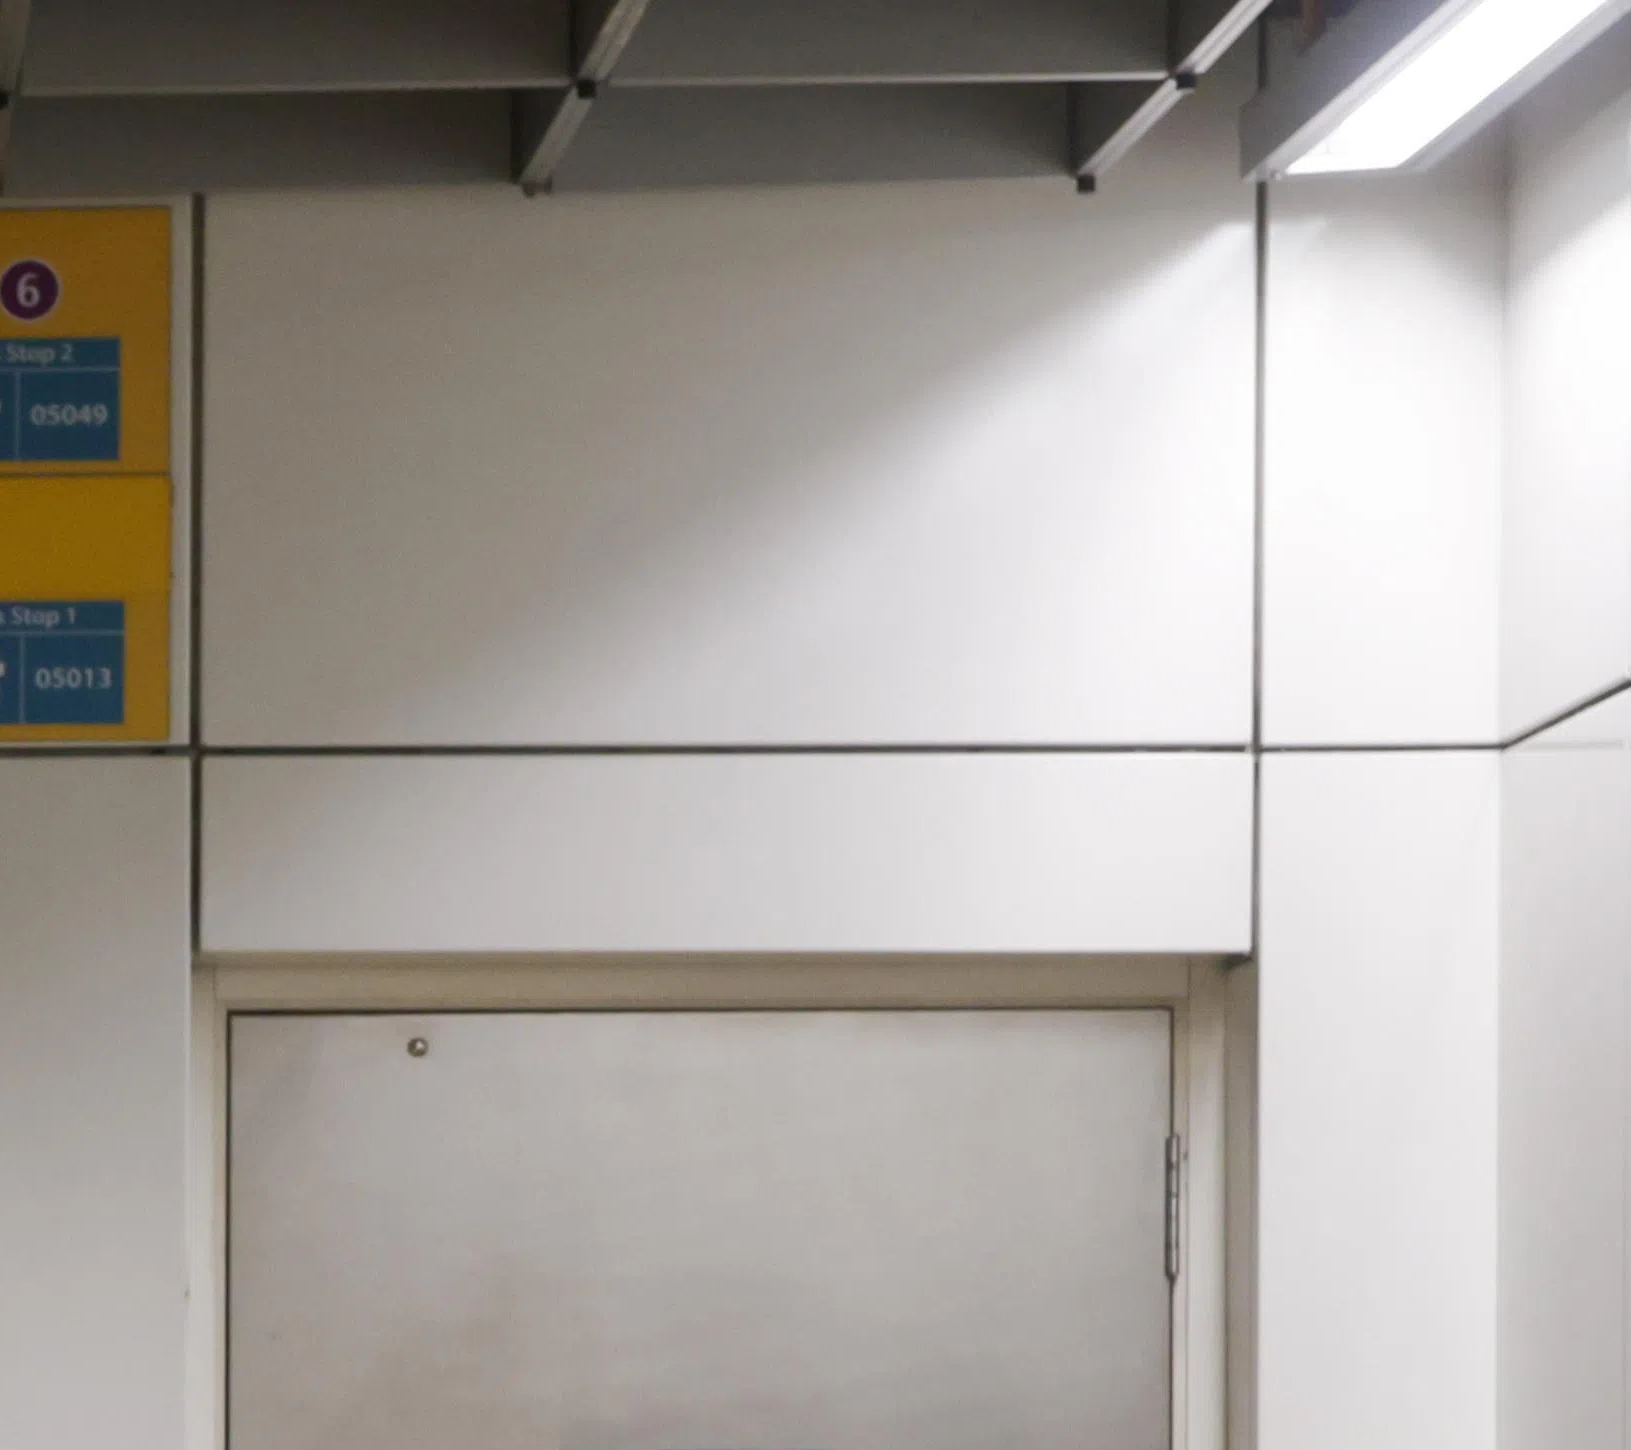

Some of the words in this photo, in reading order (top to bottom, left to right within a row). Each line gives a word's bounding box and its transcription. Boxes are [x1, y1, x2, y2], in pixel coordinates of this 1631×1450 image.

[16, 272, 41, 307] 6
[6, 343, 55, 366] Stop
[61, 344, 74, 361] 2
[29, 403, 109, 426] 05049
[11, 606, 61, 630] Stop
[68, 607, 77, 624] 1
[35, 668, 112, 690] 05013
